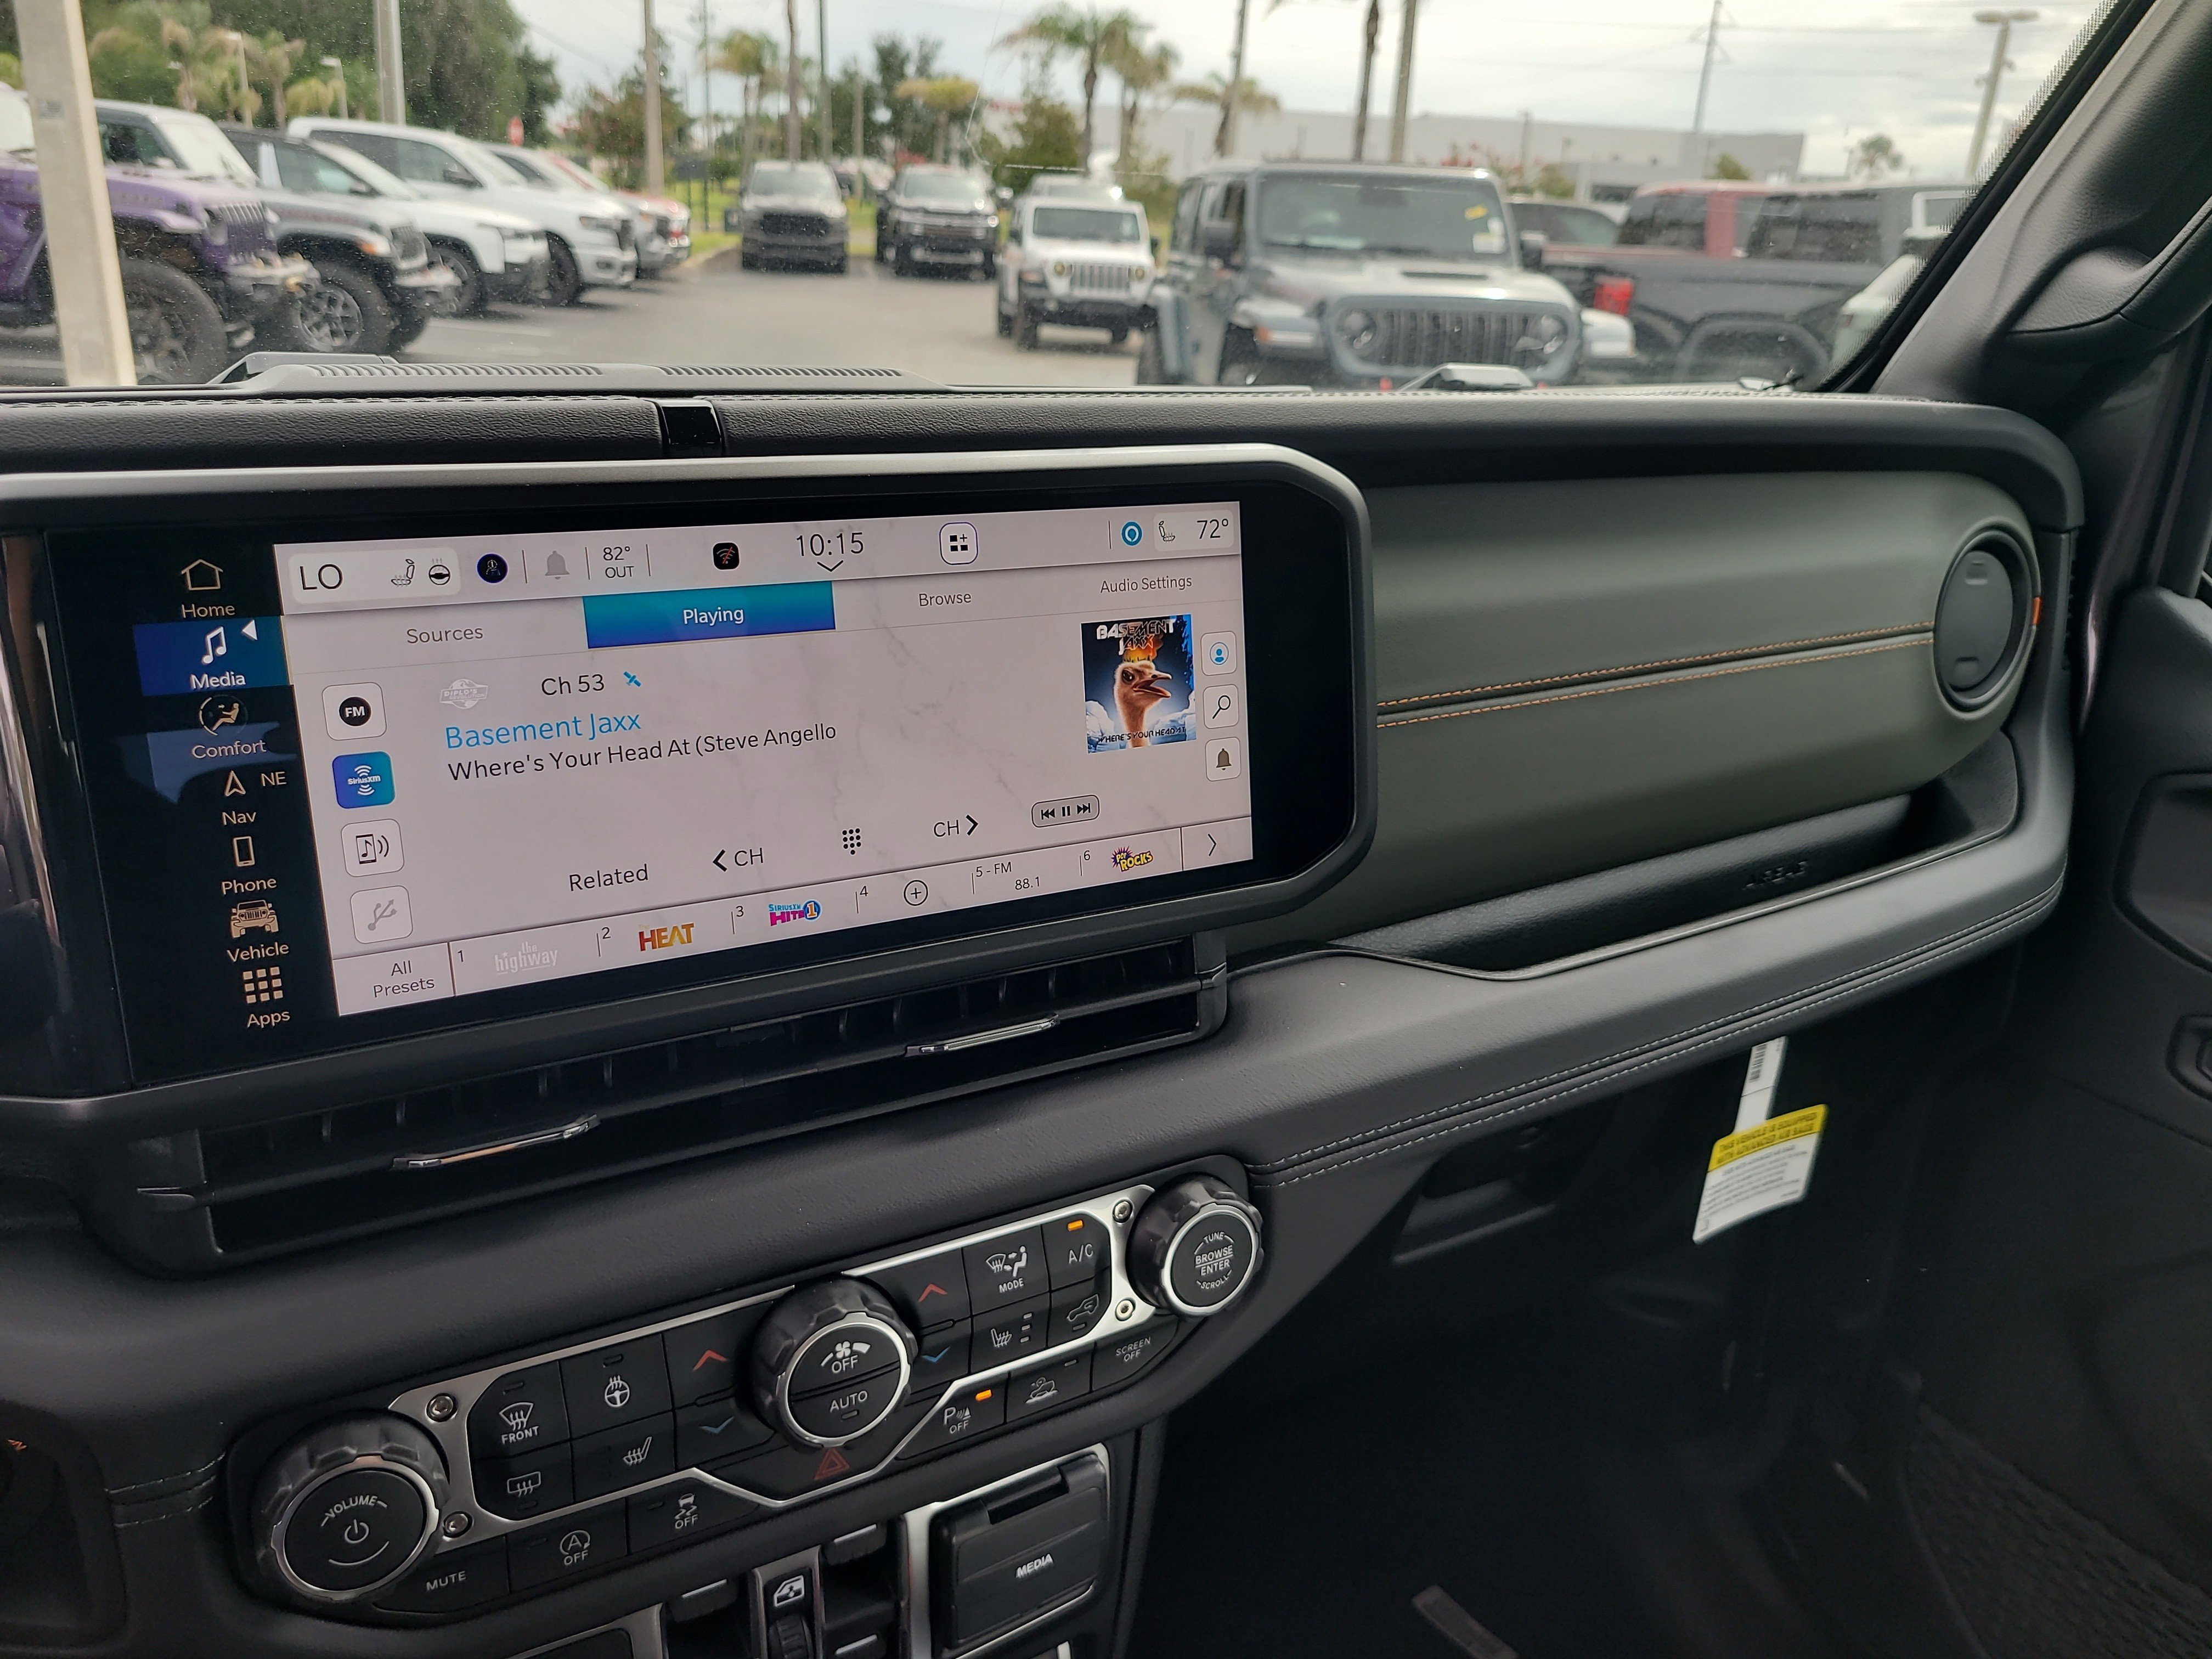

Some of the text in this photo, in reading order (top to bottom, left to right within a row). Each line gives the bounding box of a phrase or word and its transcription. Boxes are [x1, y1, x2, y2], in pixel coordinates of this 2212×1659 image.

[1197, 518, 1229, 540] 72°
[602, 546, 631, 562] 82°
[796, 532, 865, 558] 10:15
[300, 562, 344, 591] LO
[605, 566, 634, 579] OUT
[1100, 575, 1193, 594] Audio Settings
[918, 591, 972, 607] Browse
[182, 601, 236, 619] Home
[682, 607, 744, 625] Playing
[406, 625, 484, 645] Sources
[1096, 619, 1176, 640] BASEMENT
[1119, 634, 1155, 656] JAXX
[190, 670, 246, 690] Media
[540, 674, 605, 696] Ch 53
[443, 688, 478, 697] DIPLO'S
[345, 706, 366, 718] FM
[445, 713, 642, 749] Basement Jaxx
[1098, 733, 1131, 743] WHERE'S
[1132, 730, 1154, 739] YOUR
[1155, 727, 1176, 737] HEAD
[191, 739, 267, 759] Comfort
[448, 723, 837, 781] Where's Your Head At (Steve Angello
[261, 771, 287, 787] NE
[222, 810, 257, 826] Nav
[933, 819, 961, 838] CH
[734, 847, 764, 867] CH
[1083, 850, 1091, 861] 6
[1120, 851, 1153, 871] ROCKS
[569, 864, 649, 891] Related
[976, 865, 984, 878] 5
[994, 861, 1012, 875] FM
[221, 877, 278, 895] Phone
[859, 885, 869, 898] 4
[1014, 876, 1041, 891] 88.1
[736, 905, 744, 917] 3
[601, 927, 612, 939] 2
[639, 923, 695, 951] HEAT
[227, 941, 290, 963] Vehicle
[458, 950, 464, 963] 1
[521, 941, 538, 953] the
[391, 960, 413, 977] All
[494, 950, 558, 973] highway
[373, 977, 435, 999] Presets
[246, 1009, 291, 1029] Apps
[1203, 1231, 1224, 1245] TUNE
[1068, 1243, 1094, 1264] A/C
[1195, 1245, 1233, 1265] BROWSE
[1200, 1259, 1231, 1276] ENTER
[999, 1278, 1025, 1293] MODE
[1200, 1273, 1229, 1291] SCROLL
[1115, 1336, 1151, 1357] SCREEN
[1124, 1347, 1142, 1363] OFF
[832, 1355, 859, 1374] OFF
[829, 1390, 868, 1413] AUTO
[501, 1425, 539, 1444] FRONT
[949, 1419, 969, 1434] OFF
[325, 1494, 379, 1520] VOLUME
[674, 1514, 698, 1530] OFF
[563, 1550, 589, 1565] OFF
[1015, 1553, 1054, 1579] MEDIA
[426, 1571, 467, 1591] MUTE
